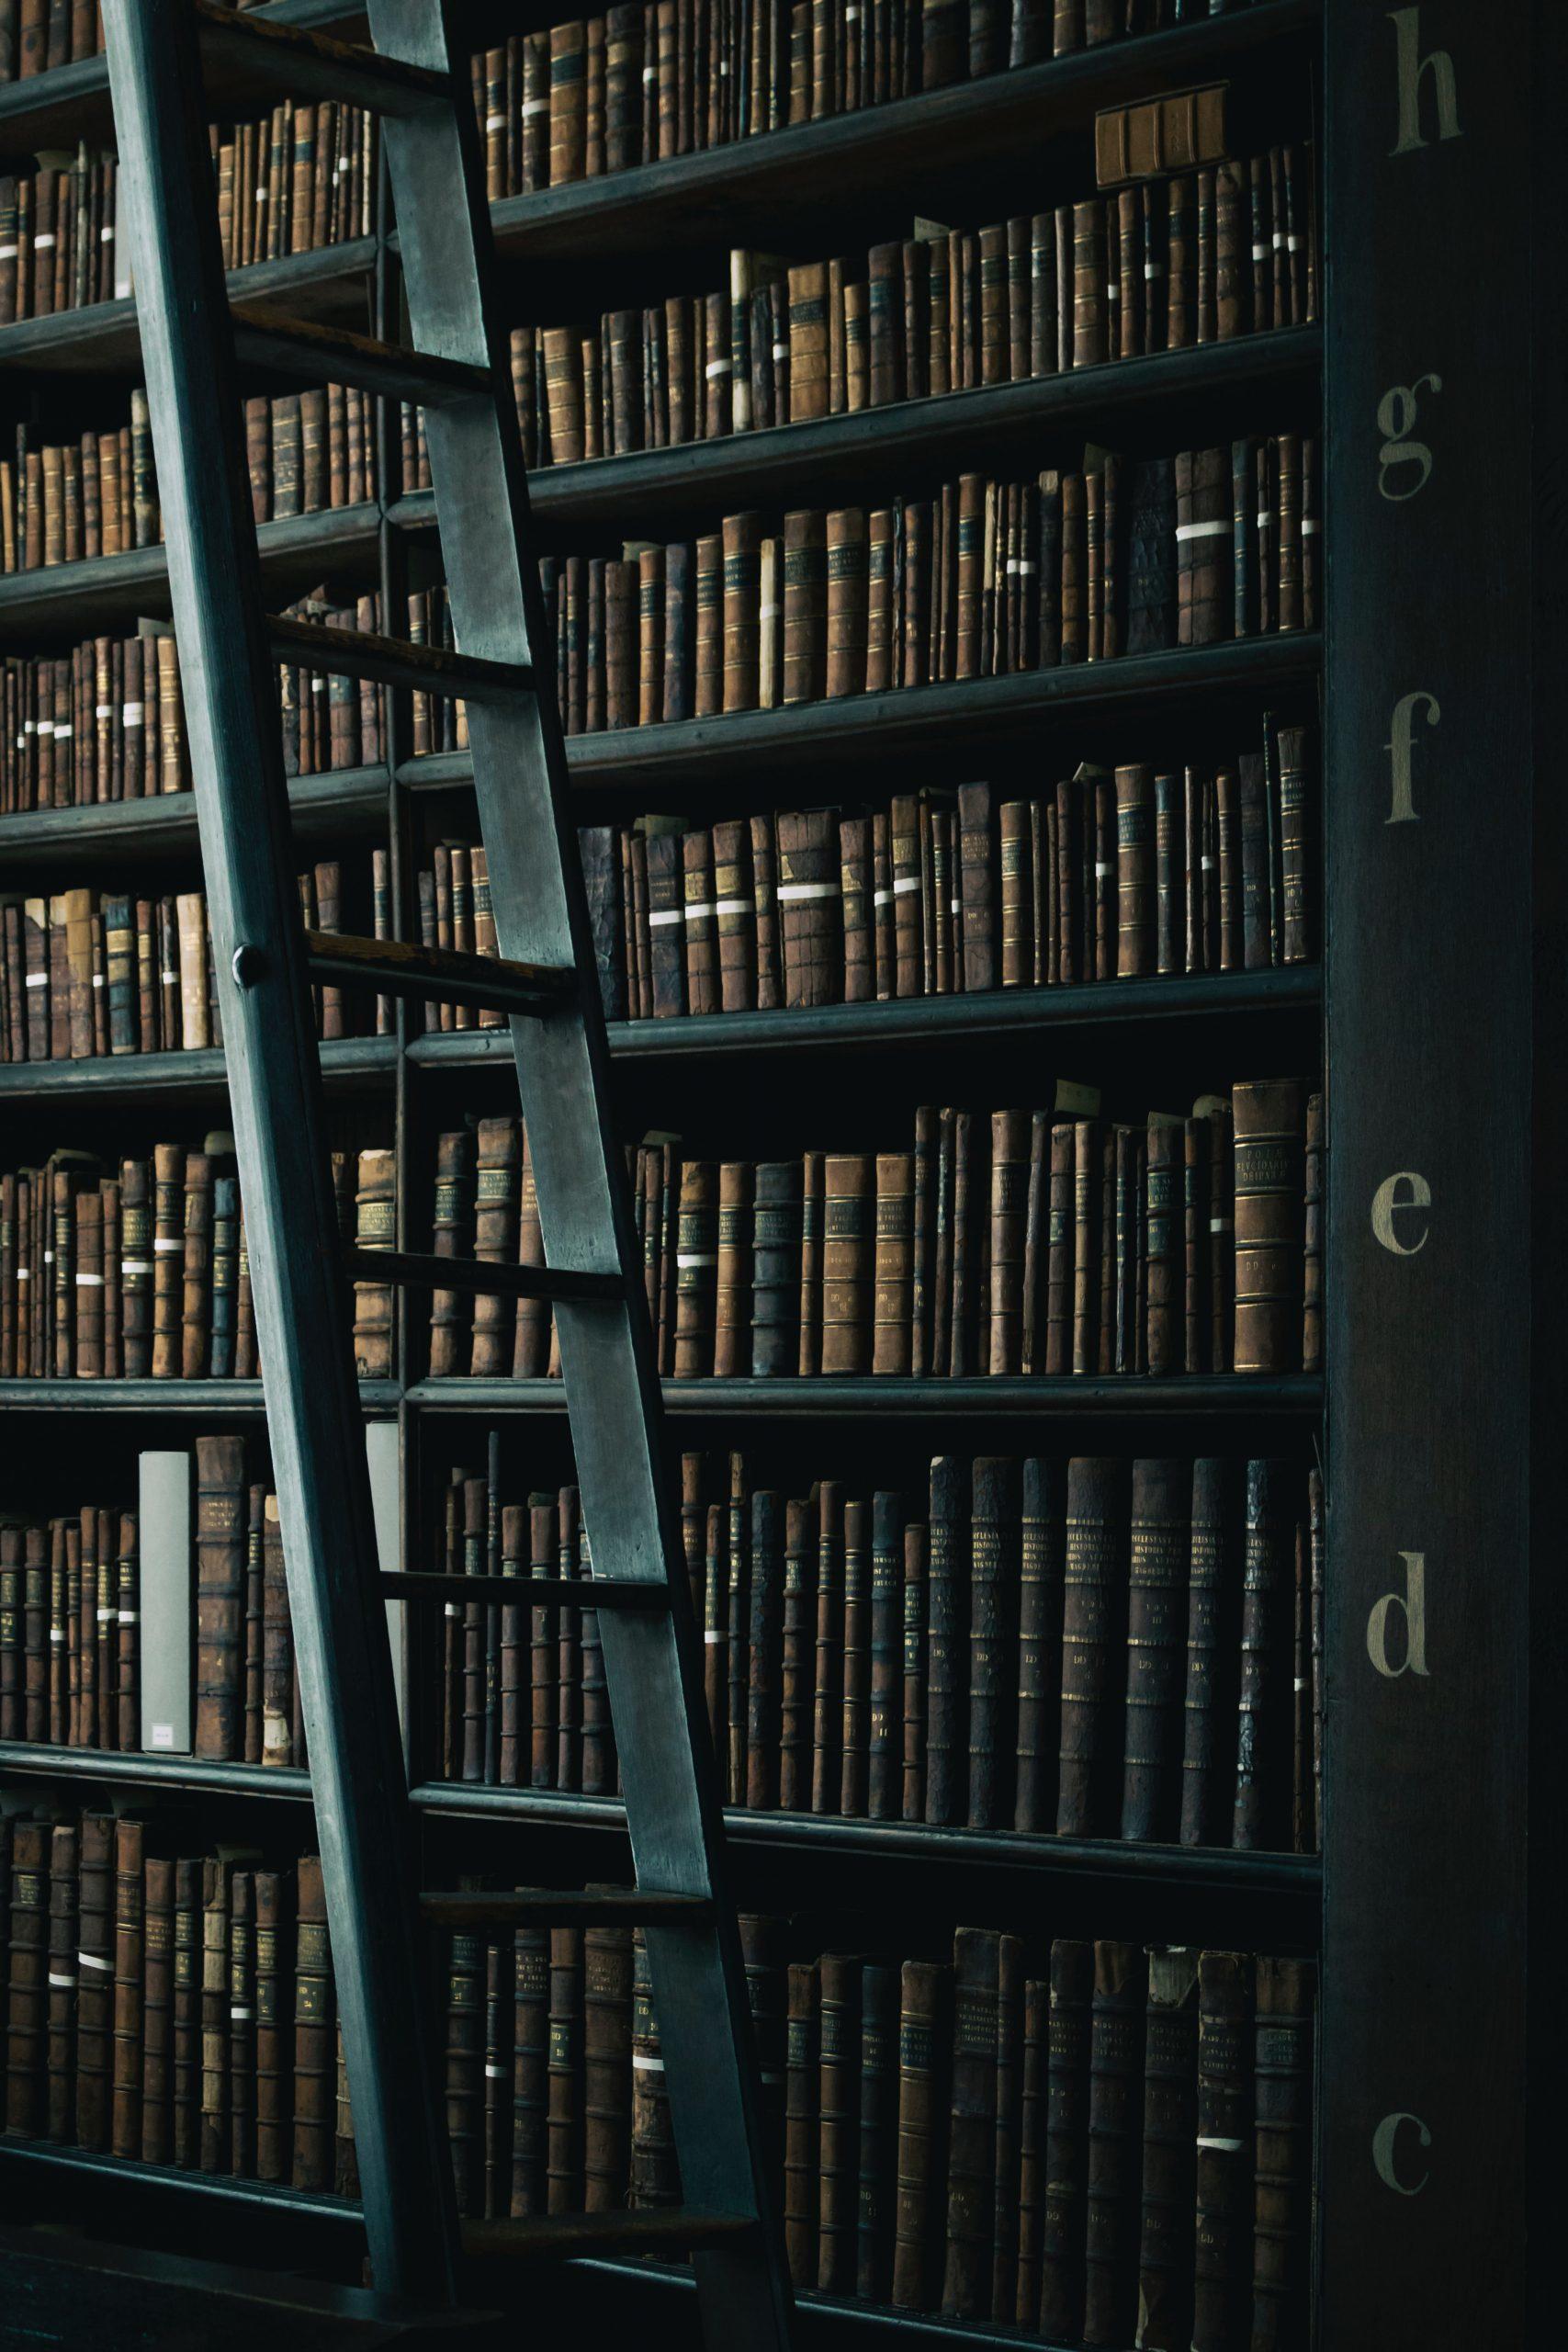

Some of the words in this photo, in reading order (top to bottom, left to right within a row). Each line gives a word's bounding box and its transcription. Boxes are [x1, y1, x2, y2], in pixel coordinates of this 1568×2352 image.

[1386, 6, 1463, 156] h
[1377, 373, 1442, 502] g
[1383, 691, 1440, 824] f
[1370, 1170, 1432, 1256] e
[1366, 1550, 1430, 1679] d
[1372, 2112, 1431, 2196] c
